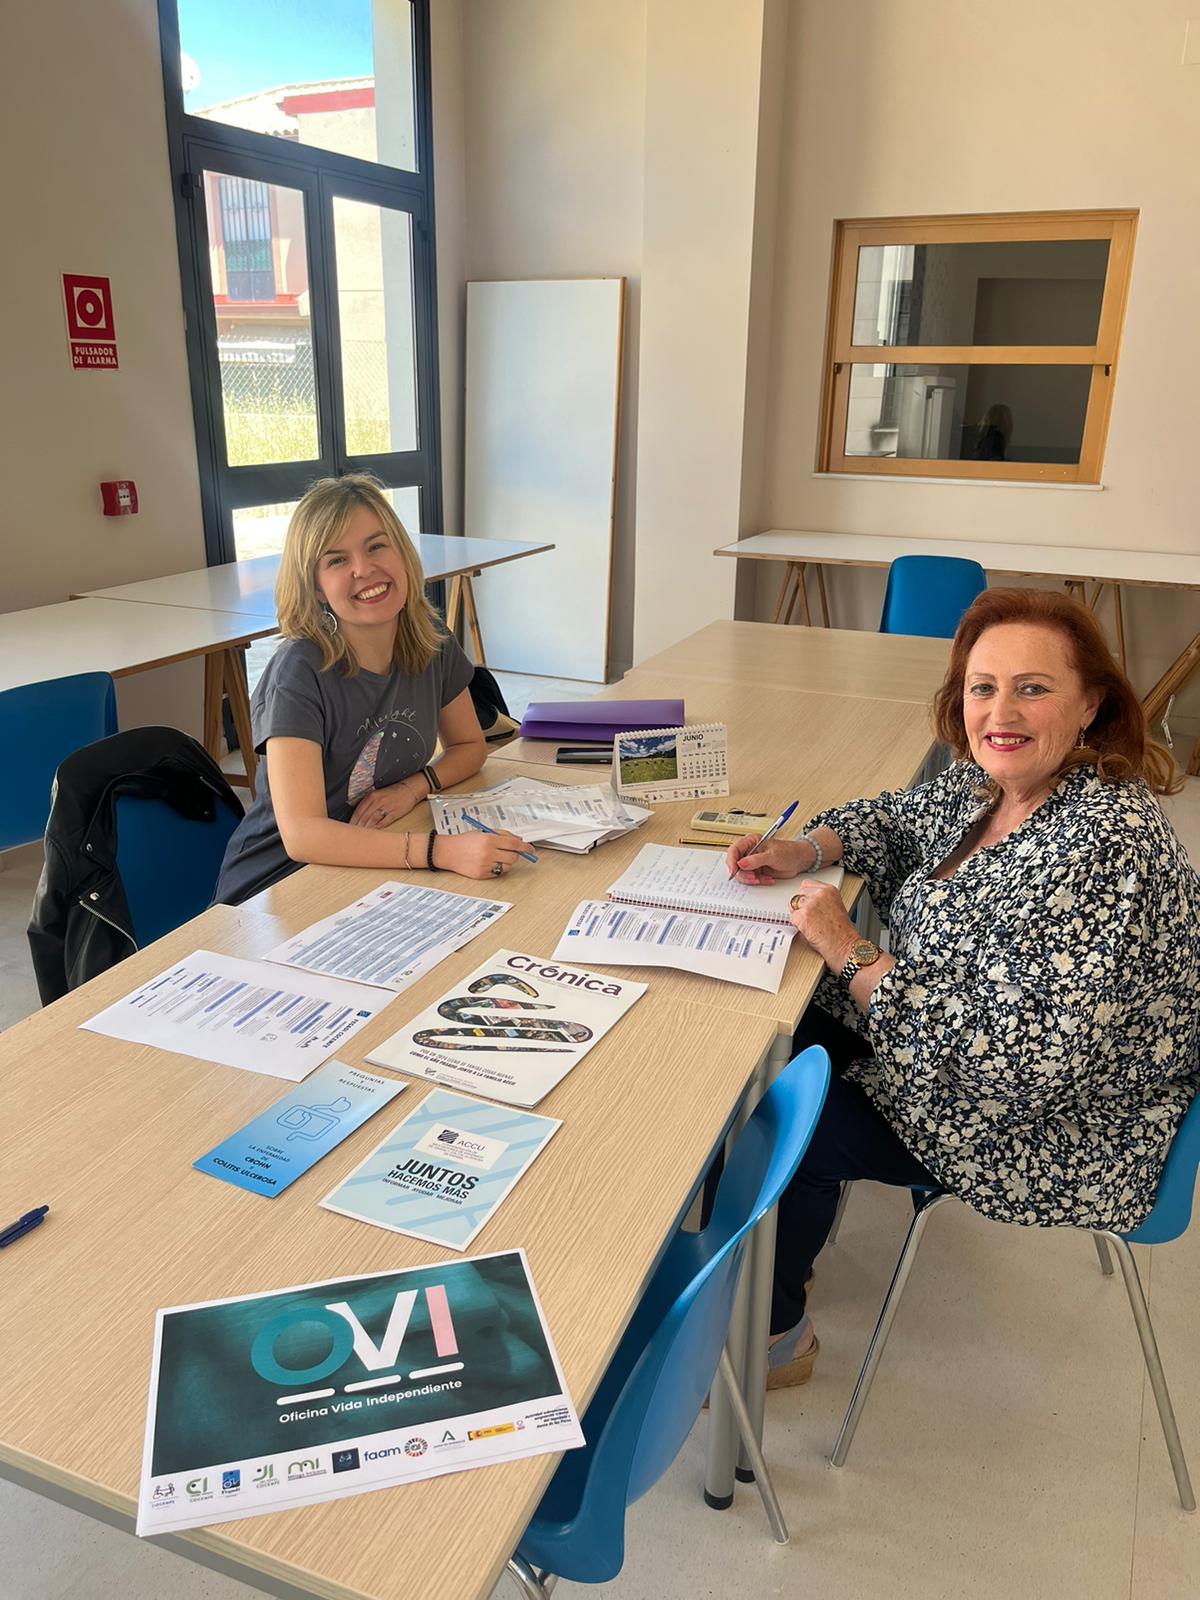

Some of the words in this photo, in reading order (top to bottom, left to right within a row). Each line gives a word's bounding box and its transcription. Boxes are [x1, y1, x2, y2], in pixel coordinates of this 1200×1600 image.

[75, 347, 113, 356] PULSADOR
[74, 356, 83, 364] DE
[87, 357, 117, 365] ALARMA
[682, 733, 704, 742] JUNIO
[506, 956, 623, 996] Crónica
[349, 1071, 384, 1084] PREGUNTAS
[339, 1079, 375, 1092] RESPUESTAS
[266, 1145, 284, 1154] SOBRE
[457, 1140, 486, 1151] ACCU
[256, 1148, 290, 1162] ENFERMEDAD
[245, 1156, 271, 1169] CROHN
[213, 1158, 240, 1172] COLITIS
[241, 1169, 277, 1185] ULCEROSA
[396, 1159, 479, 1190] JUNTOS
[382, 1178, 410, 1189] INFORMAR
[388, 1170, 442, 1191] HACEMOS
[251, 1284, 459, 1386] OVI
[279, 1406, 329, 1424] Oficina
[331, 1399, 363, 1414] Vida
[366, 1380, 462, 1406] Independiente
[364, 1447, 401, 1461] faam
